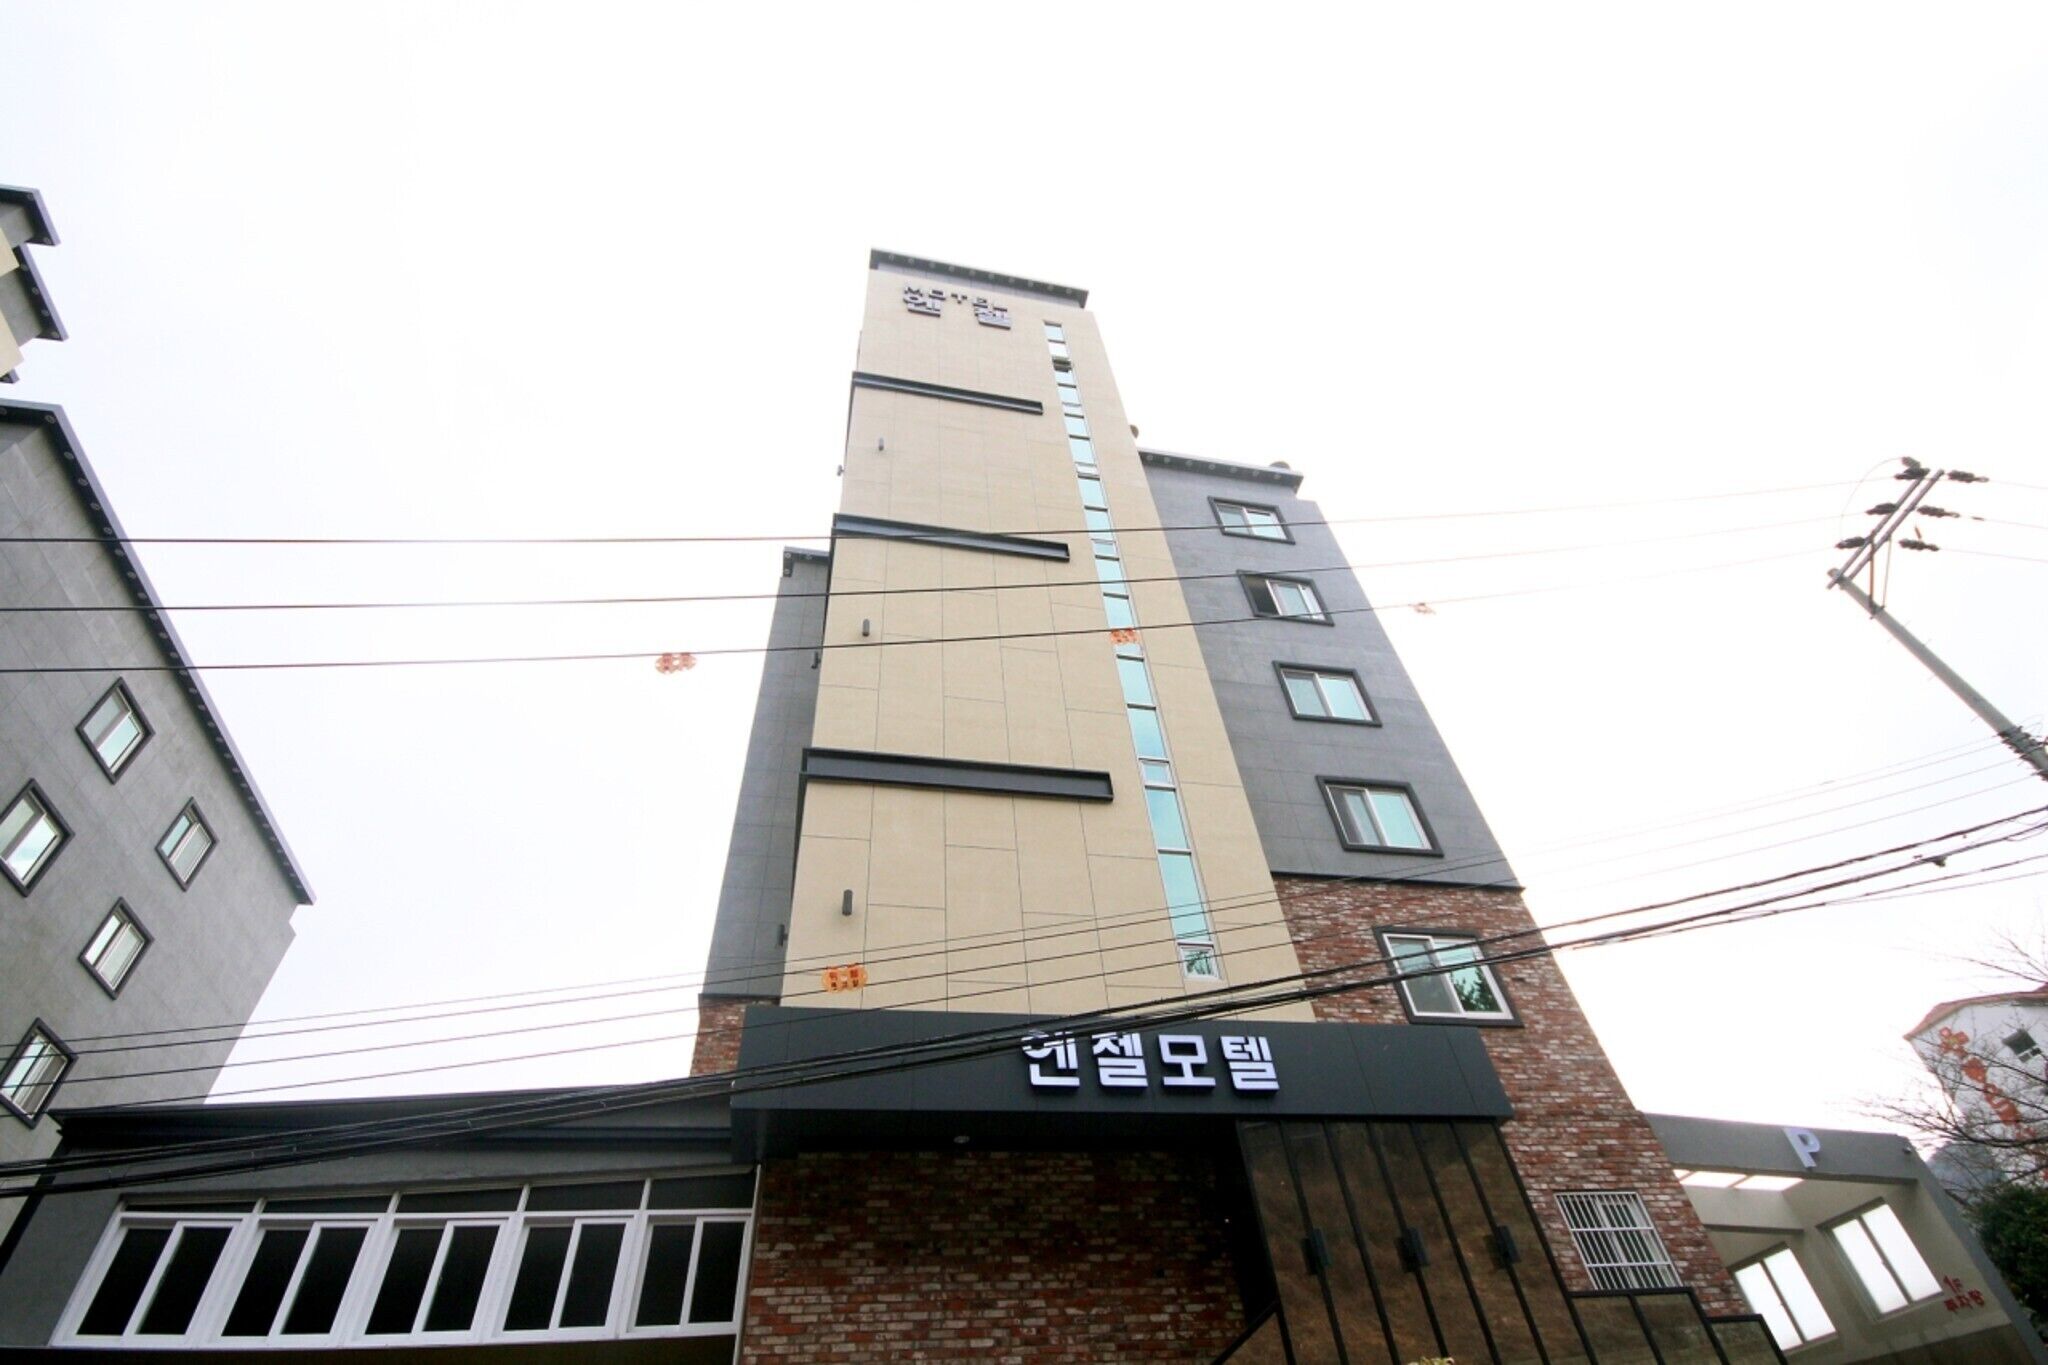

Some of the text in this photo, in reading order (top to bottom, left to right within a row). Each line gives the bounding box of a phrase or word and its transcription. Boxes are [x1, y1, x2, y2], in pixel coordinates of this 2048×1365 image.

[902, 285, 1009, 313] MOTEL
[1021, 1030, 1280, 1091] 엔젤모텔
[1783, 1127, 1821, 1168] P
